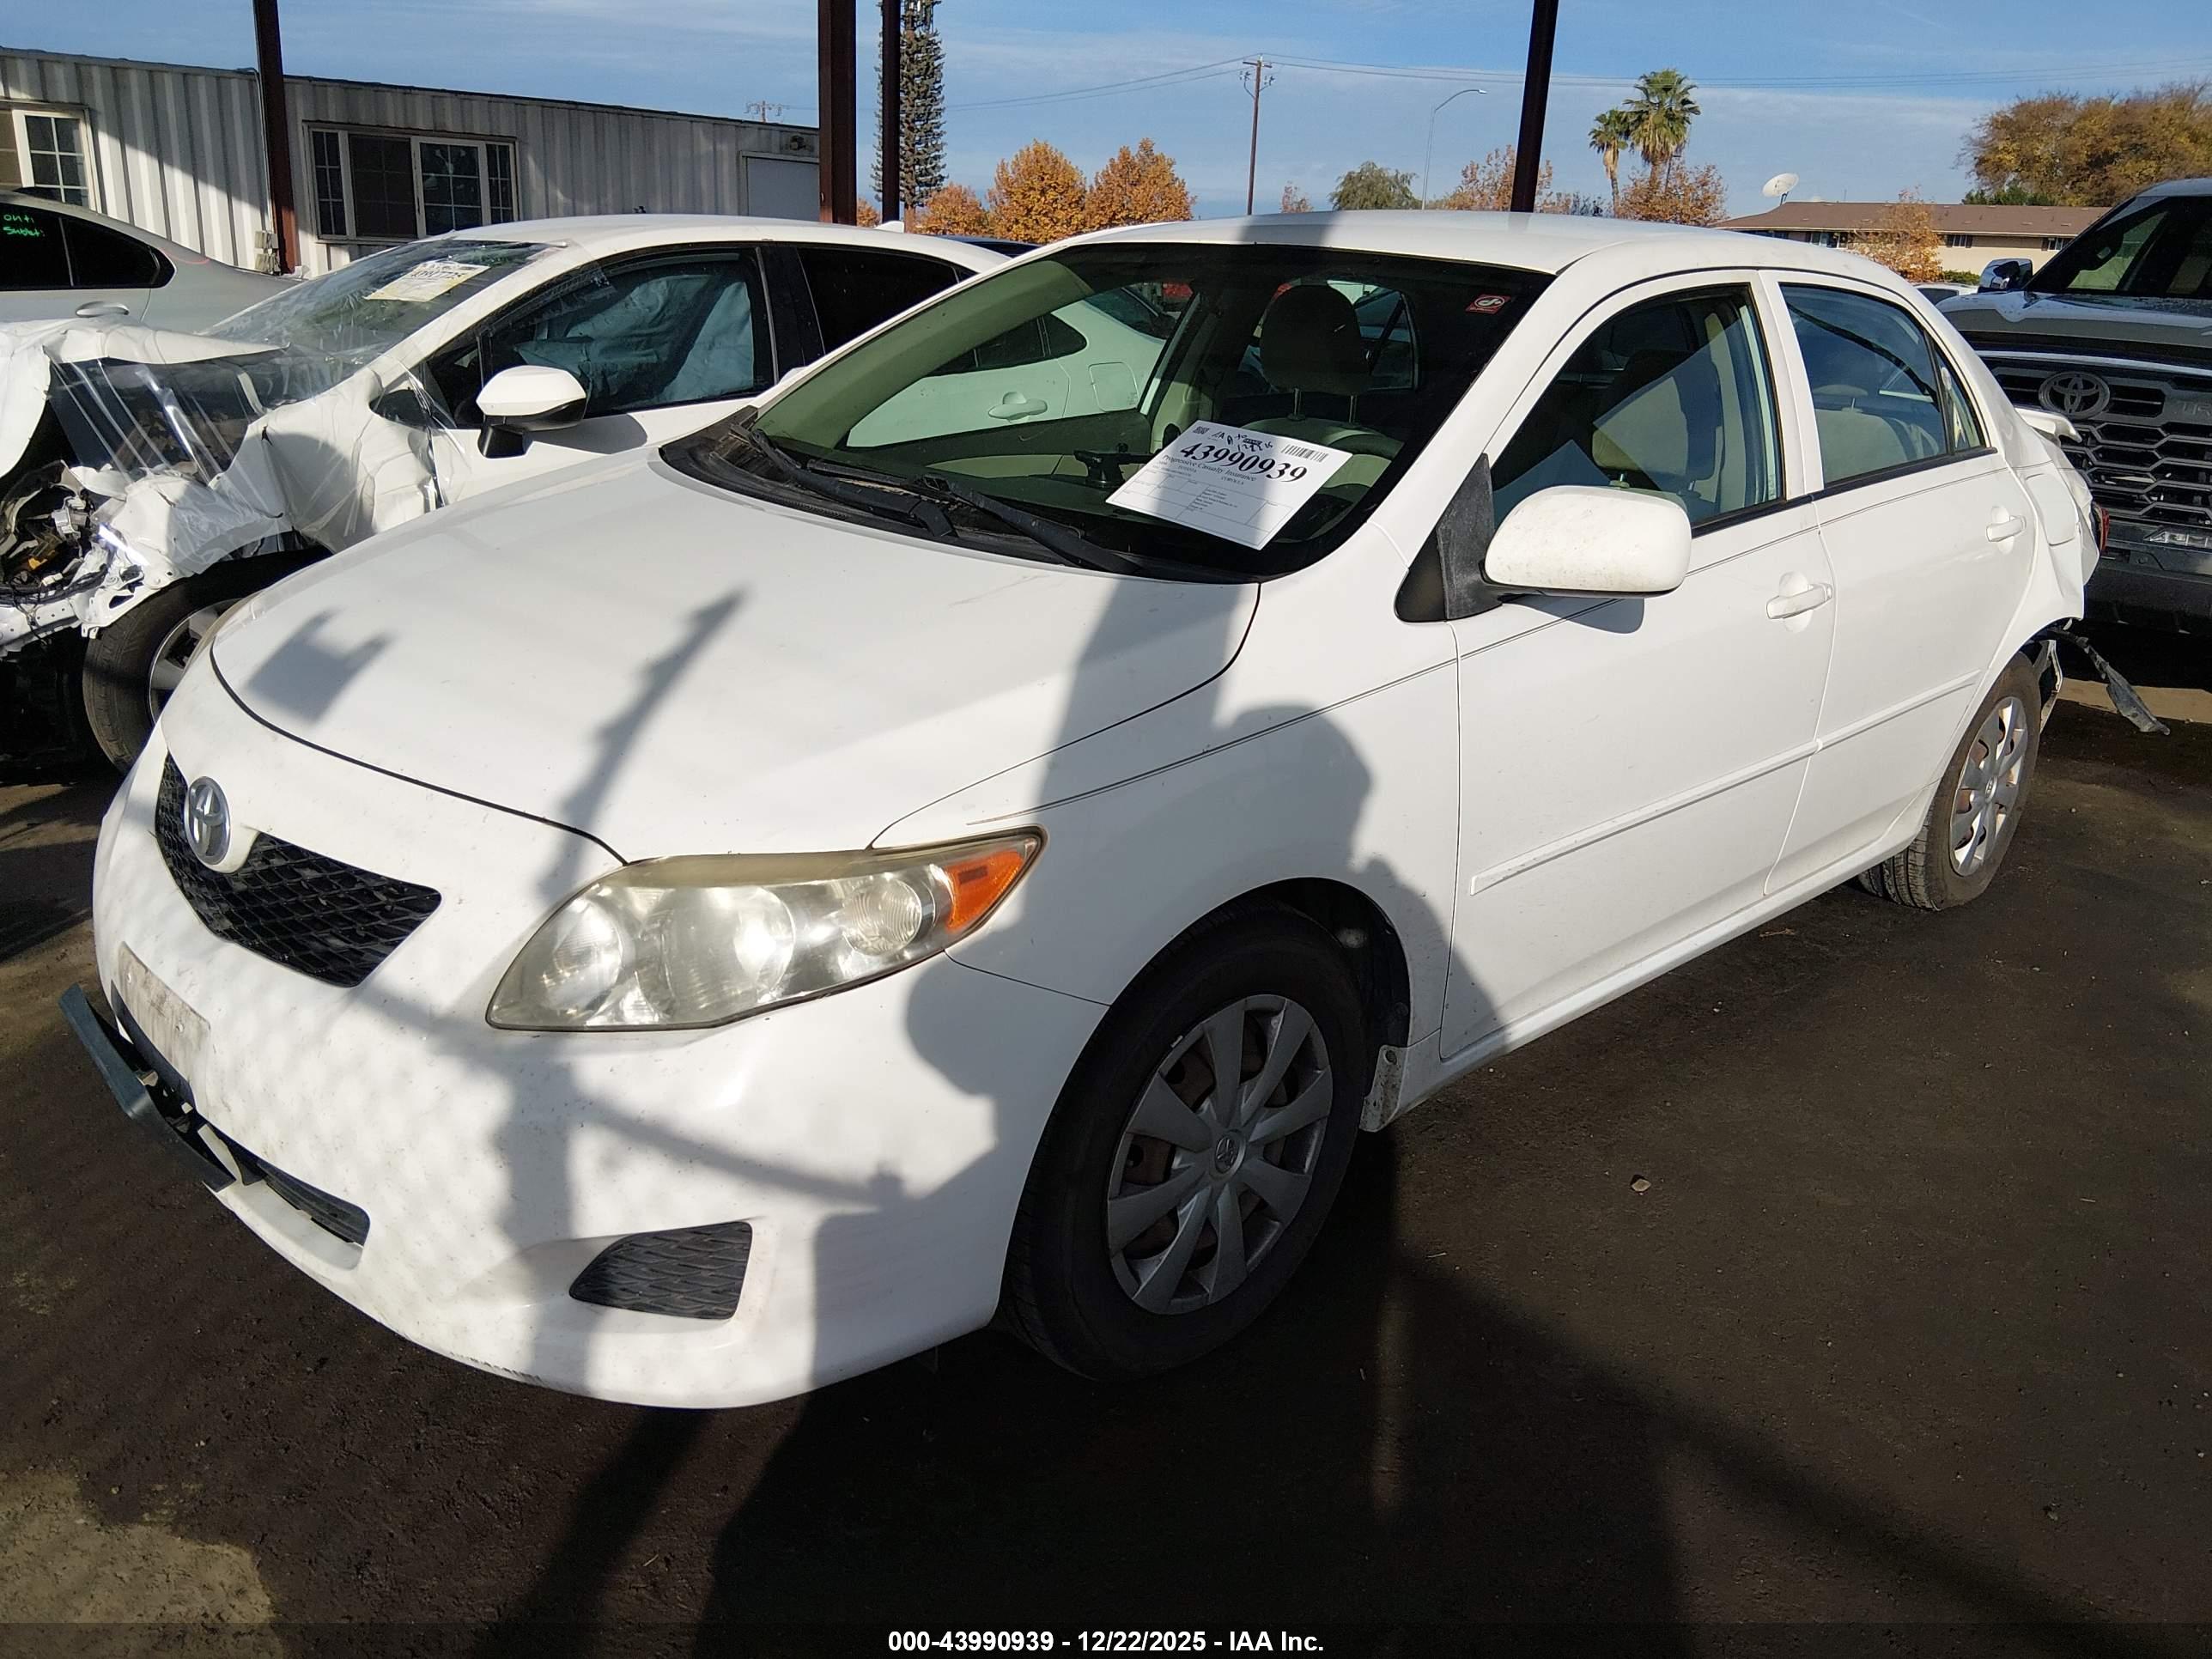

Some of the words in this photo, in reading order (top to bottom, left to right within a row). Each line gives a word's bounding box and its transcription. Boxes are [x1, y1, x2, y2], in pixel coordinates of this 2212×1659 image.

[1163, 454, 1198, 467] Progressive
[1198, 464, 1223, 474] Casualty
[1224, 470, 1257, 482] Insurance
[1180, 442, 1307, 483] 43990939
